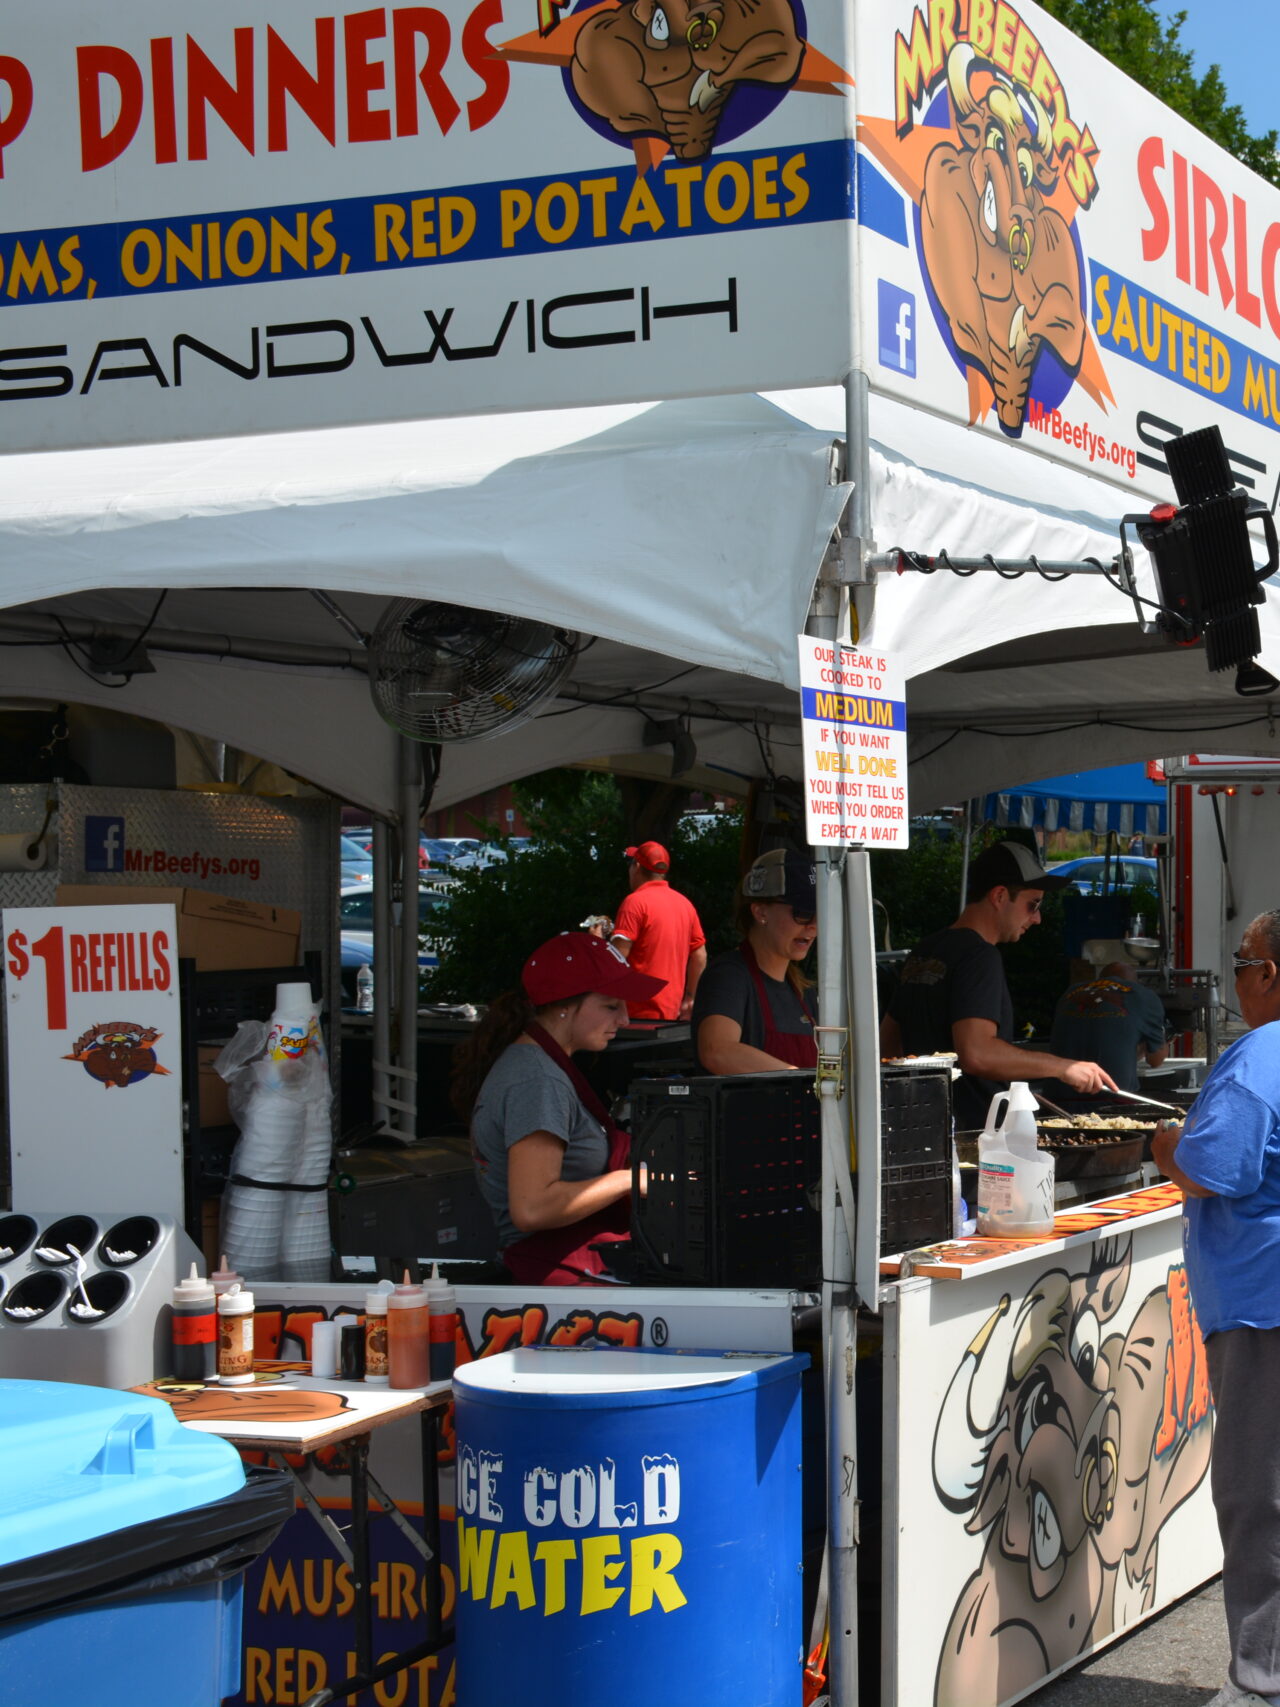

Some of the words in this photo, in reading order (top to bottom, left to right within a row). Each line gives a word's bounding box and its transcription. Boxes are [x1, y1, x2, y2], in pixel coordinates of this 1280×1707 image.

[76, 0, 511, 173] DINNERS
[969, 0, 1101, 211] BEEFY'S
[121, 210, 351, 287] ONIONS,
[374, 196, 476, 263] RED
[501, 153, 810, 249] POTATOES
[0, 277, 738, 400] SANDWICH
[1095, 274, 1231, 394] SAUTEED
[1029, 398, 1135, 478] MrBeefys.org
[814, 647, 836, 664] OUR
[839, 651, 873, 670] STEAK
[877, 658, 886, 672] IS
[820, 668, 864, 688] COOKED
[868, 676, 882, 691] TO
[815, 692, 894, 728] MEDIUM
[821, 728, 829, 742] IF
[834, 730, 855, 746] YOU
[859, 734, 890, 750] WANT
[810, 779, 832, 794] YOU
[836, 781, 863, 797] MUST
[866, 784, 888, 800] TELL
[892, 787, 904, 801] US
[815, 750, 854, 774] WELL
[858, 755, 897, 778] DONE
[811, 800, 843, 815] WHEN
[846, 802, 866, 818] YOU
[870, 804, 904, 820] ORDER
[821, 823, 857, 839] EXPECT
[860, 827, 867, 839] A
[871, 827, 898, 841] WAIT
[125, 849, 260, 880] MrBeefys.org
[7, 926, 67, 1030] $1
[70, 930, 171, 992] REFILLS
[524, 1453, 680, 1528] COLD
[457, 1516, 688, 1617] WATER
[246, 1647, 327, 1705] RED
